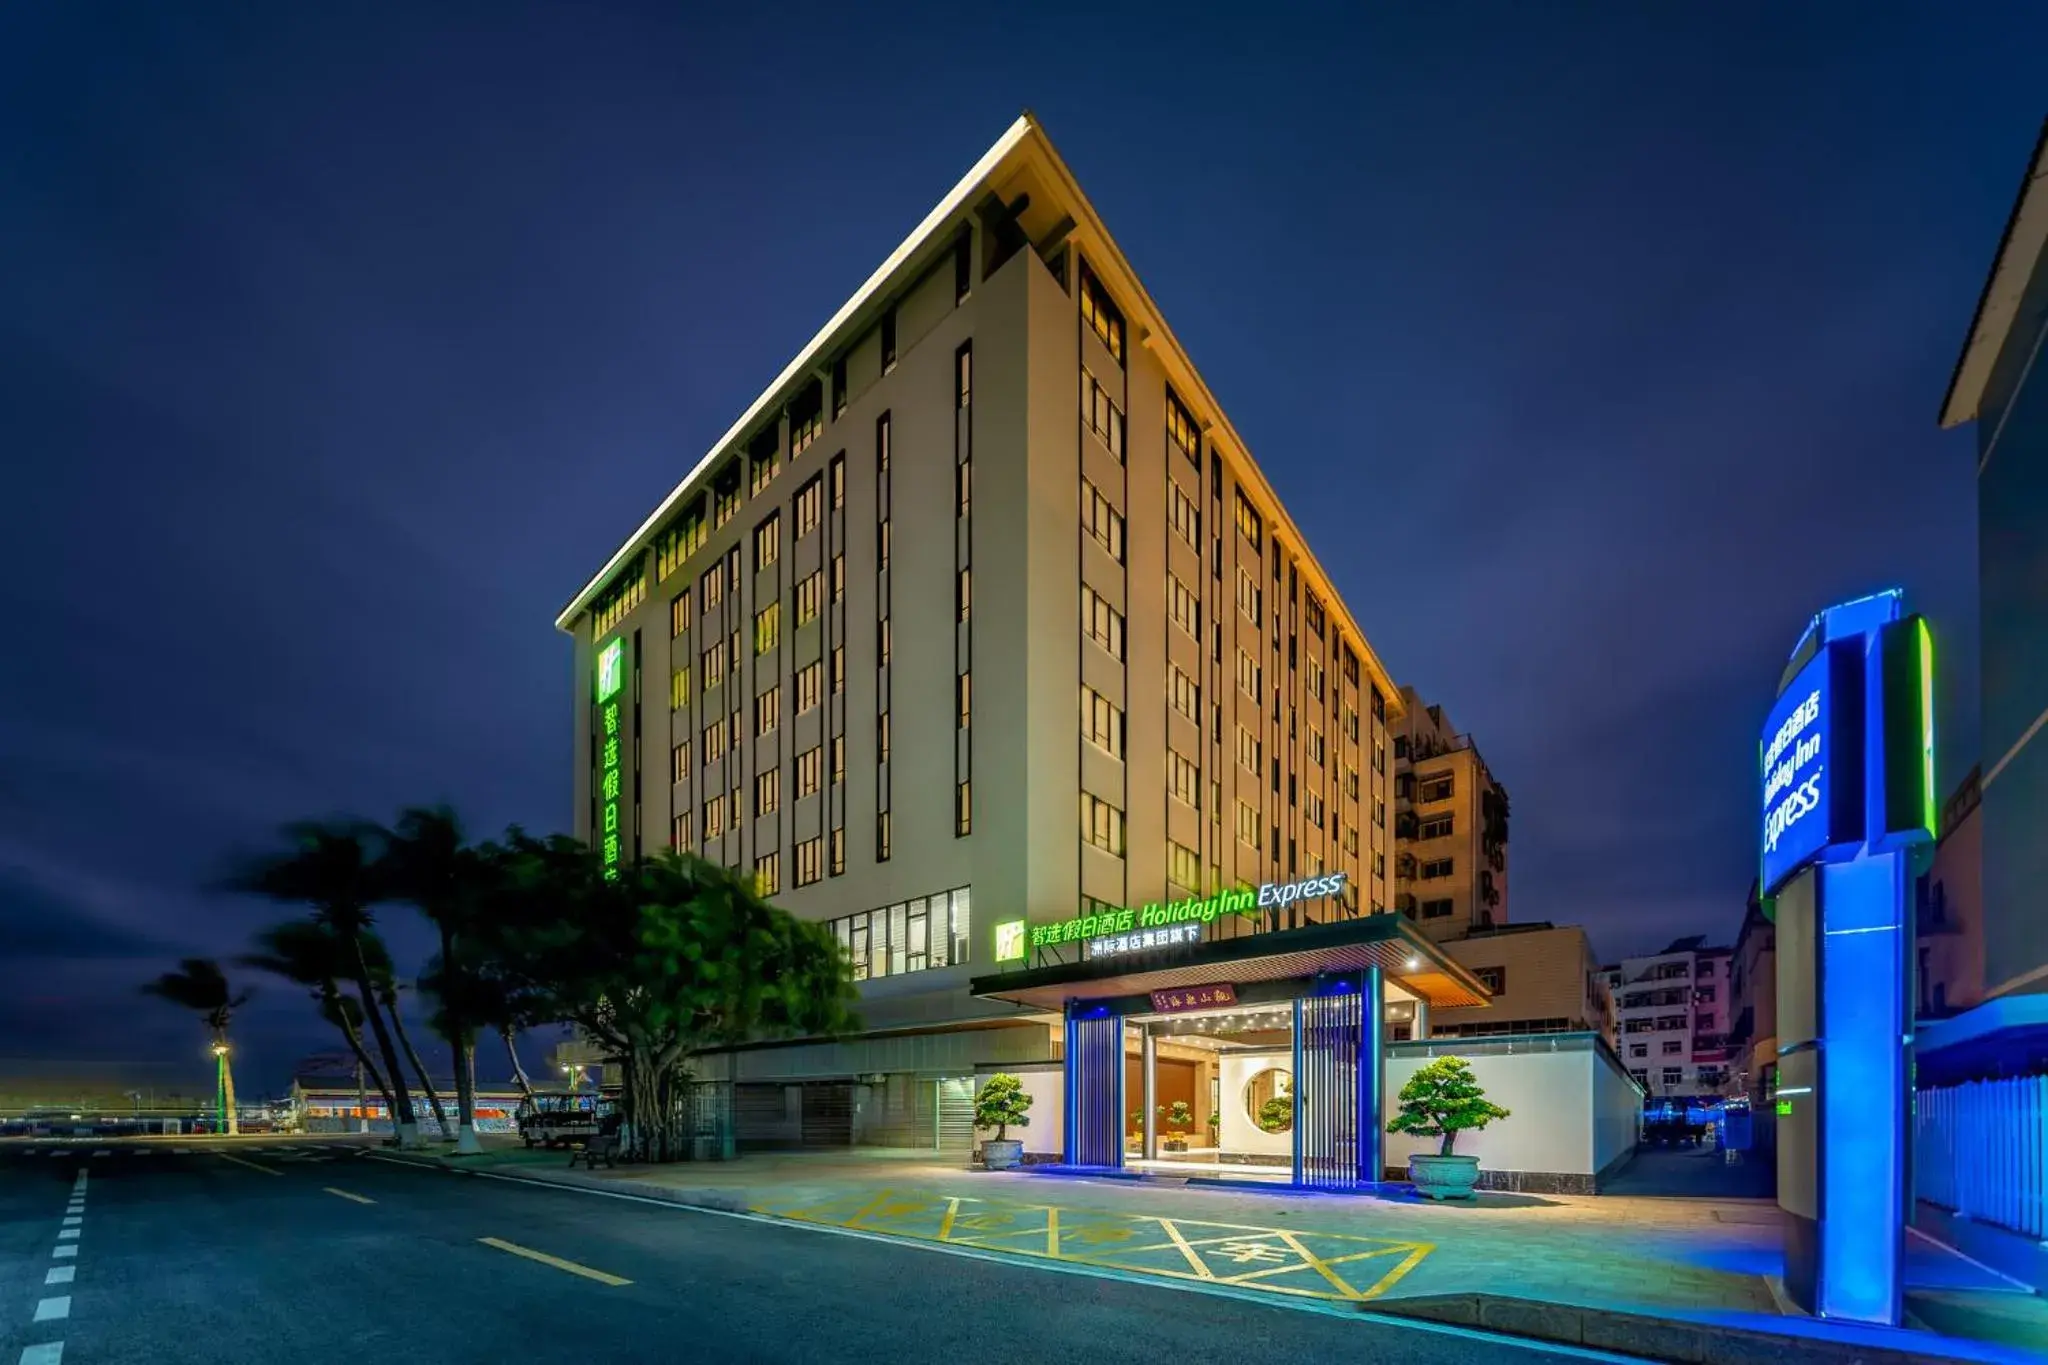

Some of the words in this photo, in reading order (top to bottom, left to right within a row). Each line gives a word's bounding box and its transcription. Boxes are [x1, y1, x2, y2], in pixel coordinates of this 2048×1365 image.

[1796, 733, 1820, 770] Inn
[1764, 772, 1820, 853] Express
[1141, 896, 1217, 926] Holiday
[1219, 889, 1255, 914] Inn
[1258, 873, 1342, 907] Express
[1031, 910, 1133, 945] 智选假日酒店
[1090, 925, 1198, 956] 洲际酒店集团旗下
